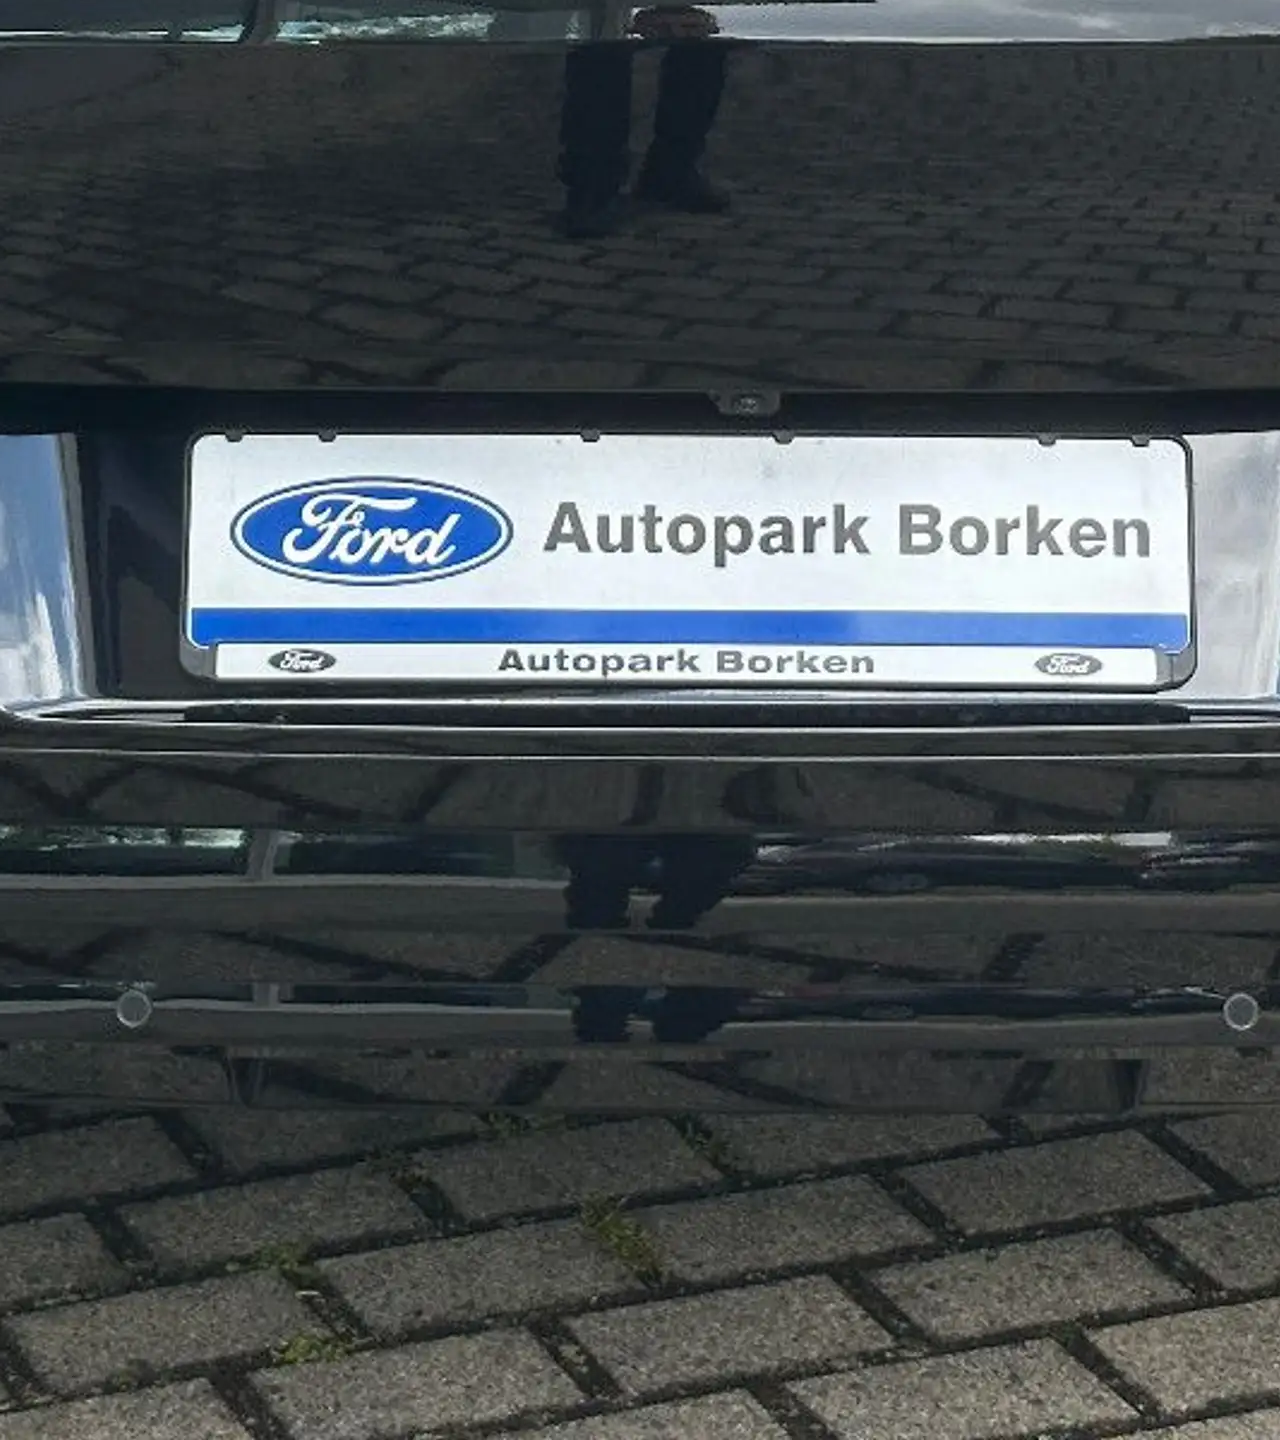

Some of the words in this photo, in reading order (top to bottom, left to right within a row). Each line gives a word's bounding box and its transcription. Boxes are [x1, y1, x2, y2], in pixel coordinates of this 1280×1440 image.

[543, 501, 872, 568] Autopark
[899, 503, 1151, 558] Borken
[498, 648, 702, 678] Autopark
[716, 649, 875, 675] Borken
